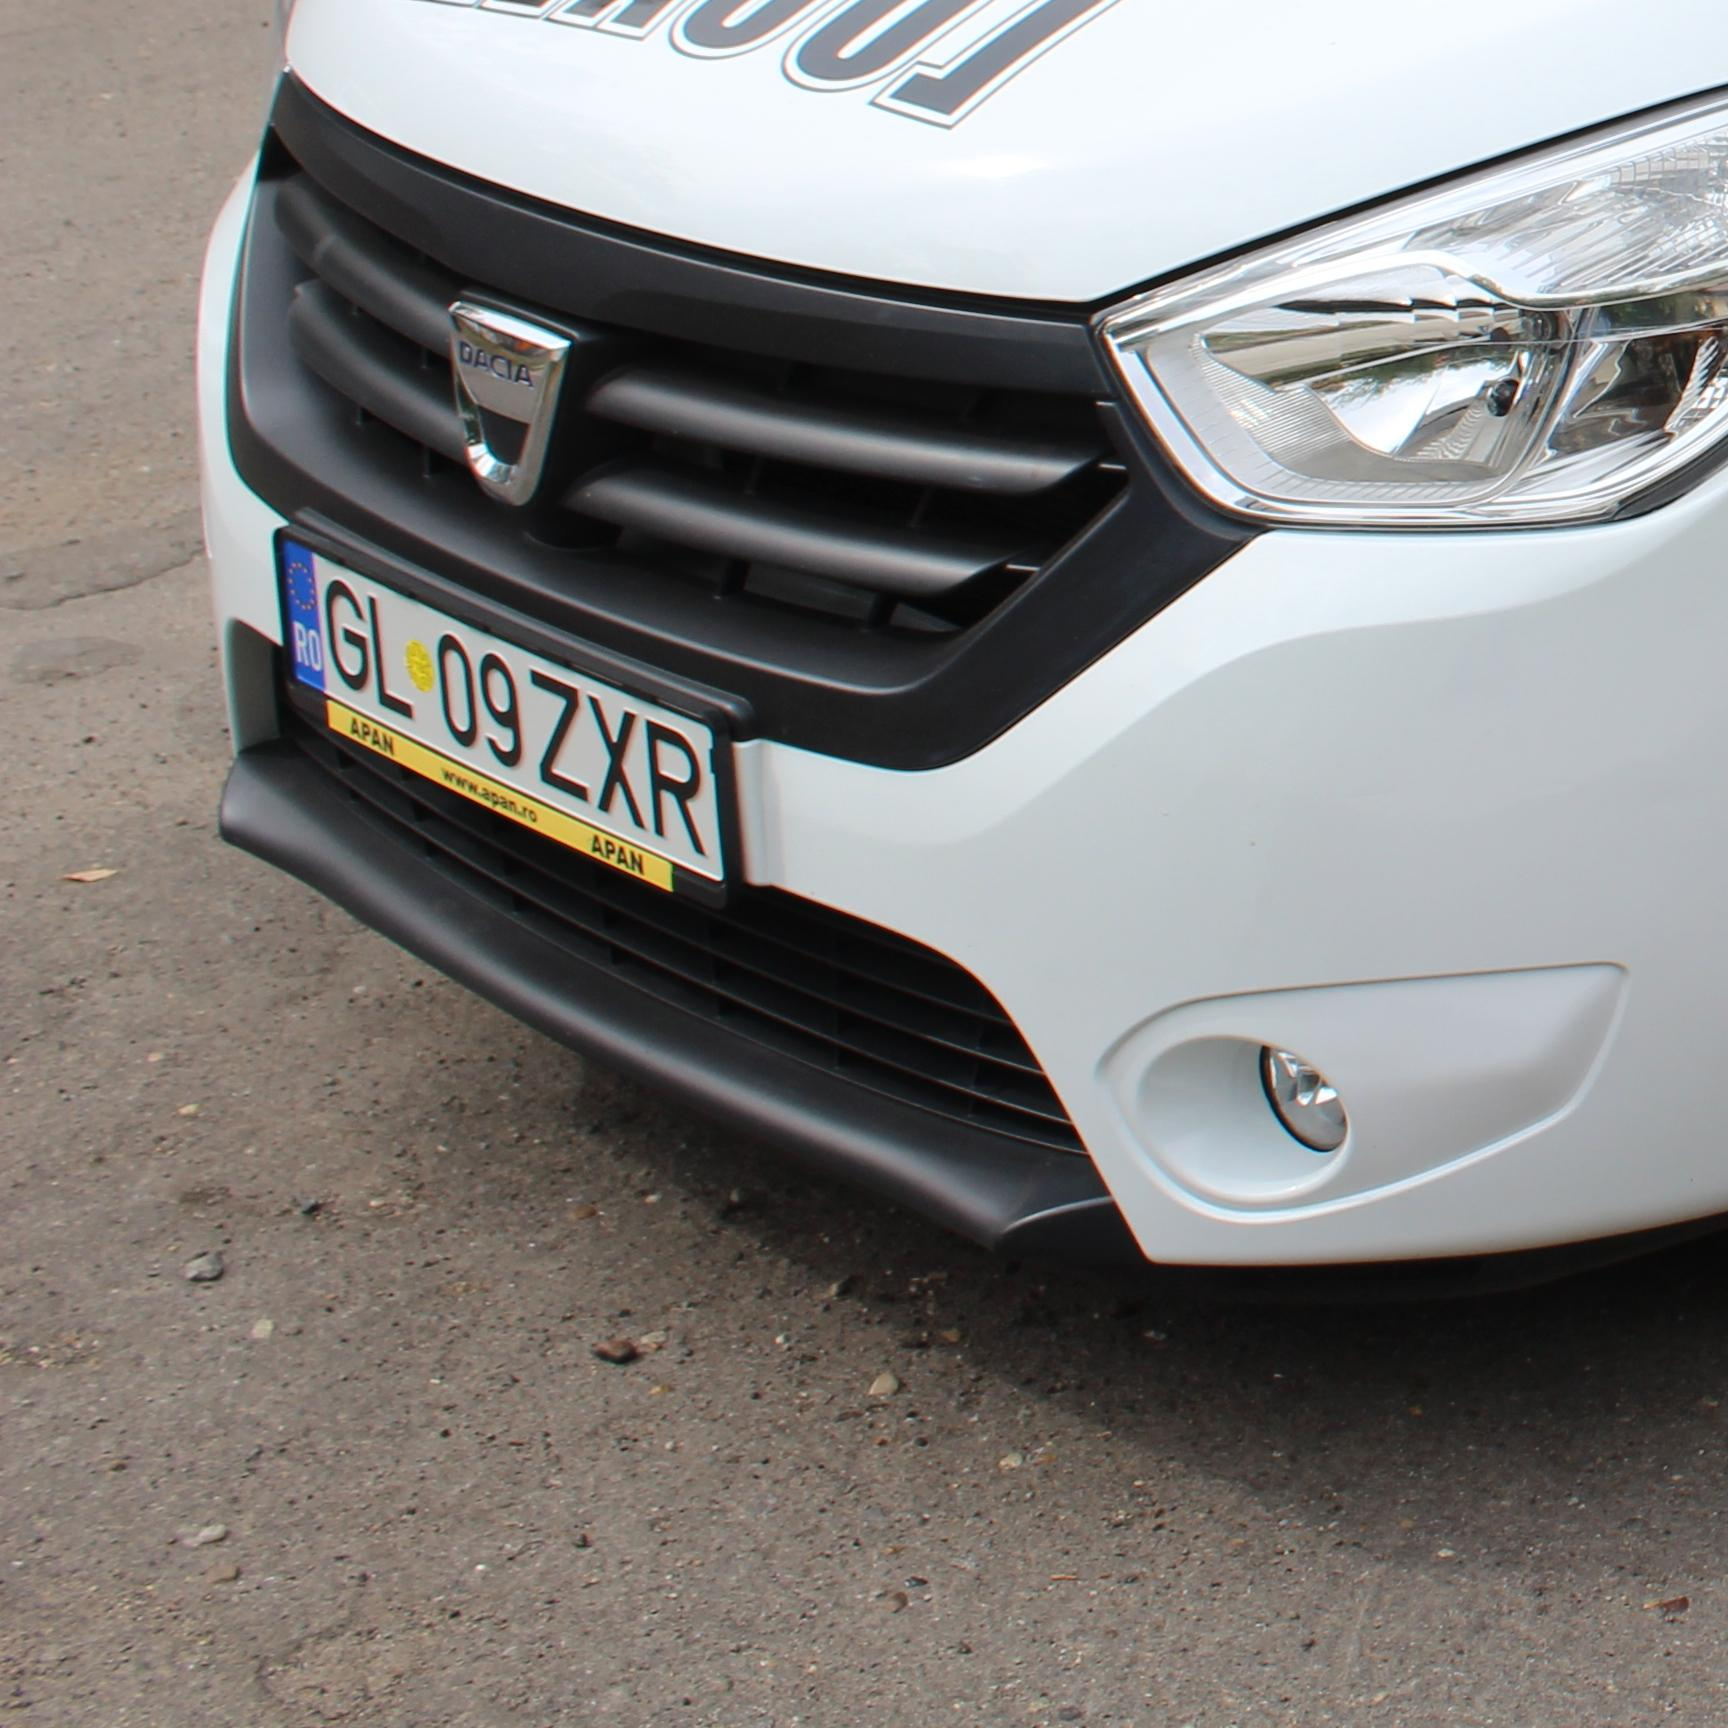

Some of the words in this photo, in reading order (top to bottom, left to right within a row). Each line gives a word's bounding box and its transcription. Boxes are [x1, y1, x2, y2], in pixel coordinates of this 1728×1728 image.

[458, 339, 536, 389] DACIA
[293, 621, 323, 672] RO
[325, 578, 415, 721] GL
[350, 717, 395, 756] APAN
[441, 767, 538, 823] www.apan.ro
[590, 834, 645, 876] APAN
